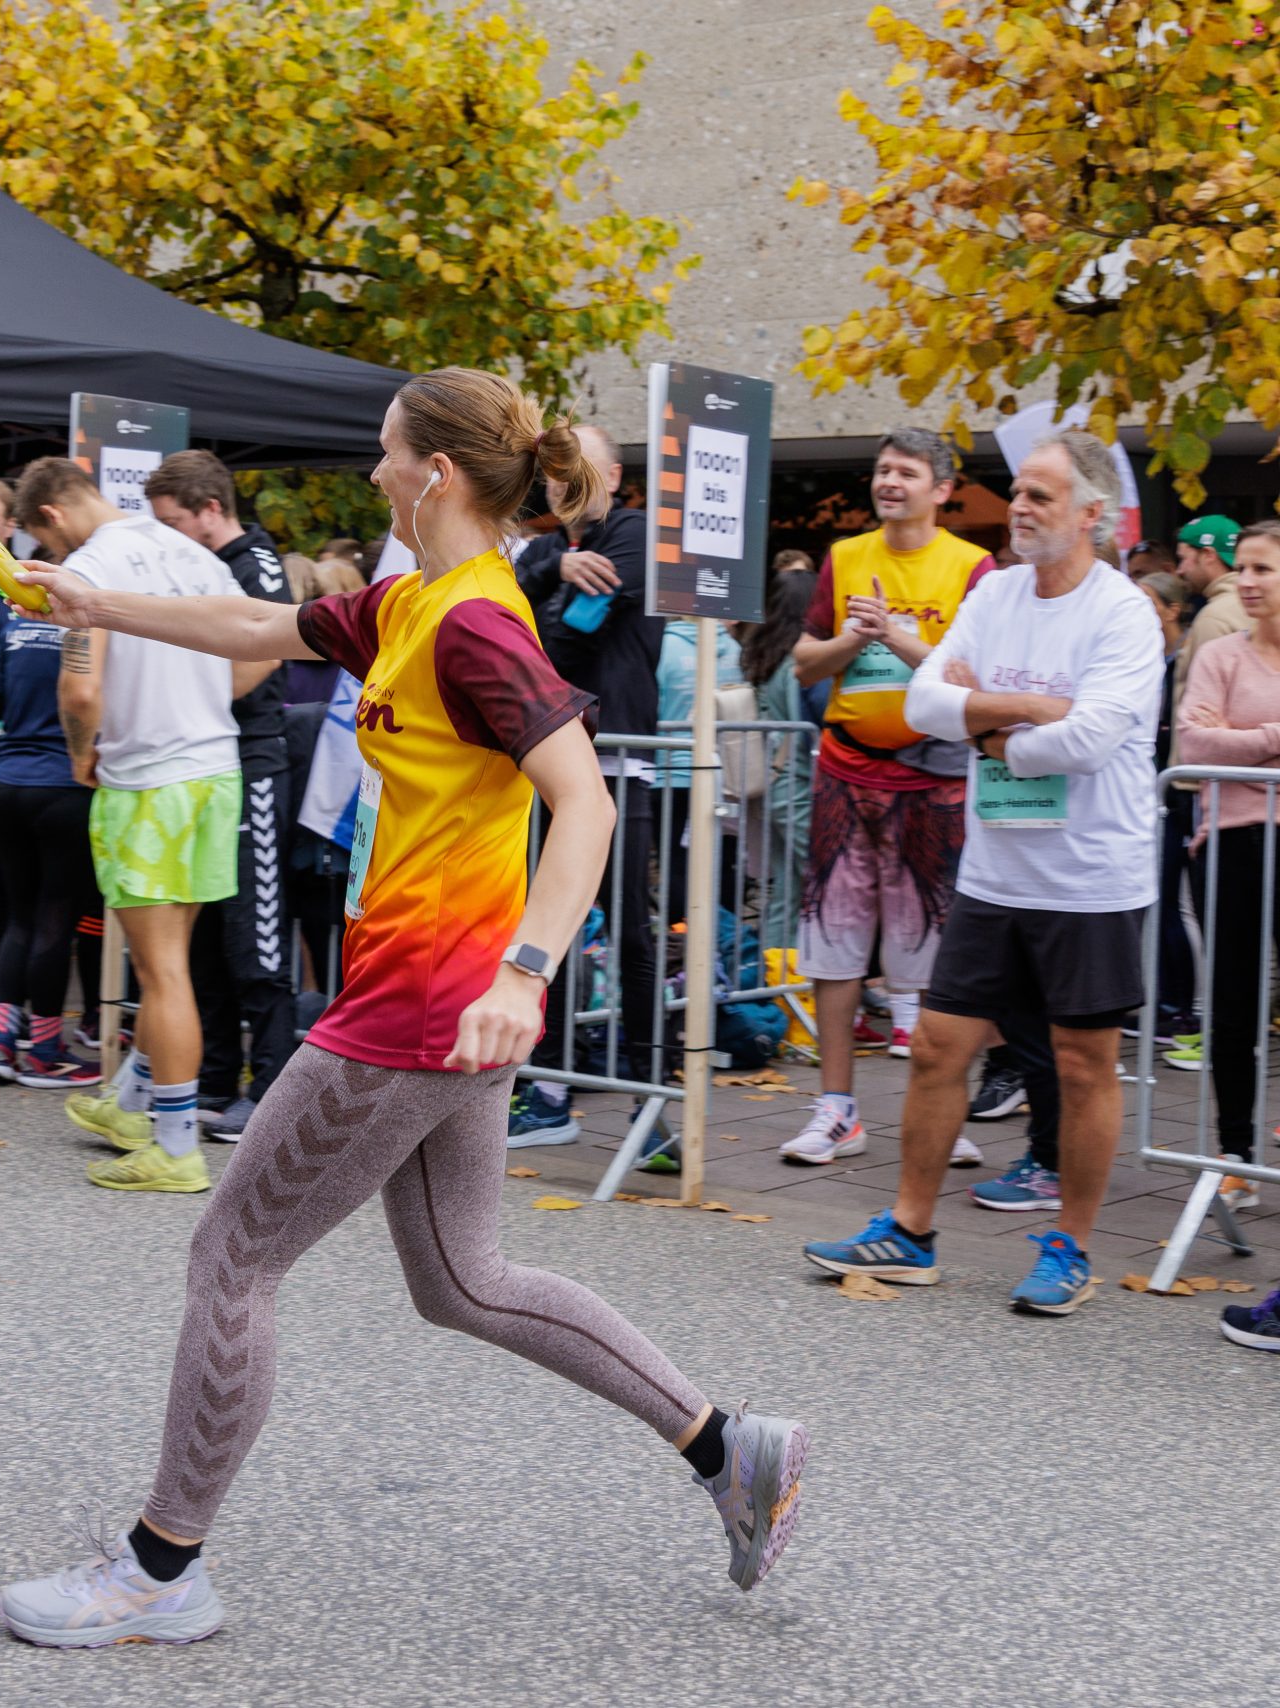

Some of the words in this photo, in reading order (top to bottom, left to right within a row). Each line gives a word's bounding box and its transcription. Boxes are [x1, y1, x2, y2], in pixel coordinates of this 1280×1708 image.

[693, 450, 740, 476] 10001
[106, 467, 148, 485] 1000
[117, 493, 143, 511] bis
[702, 481, 728, 504] bis
[689, 510, 738, 536] 10007
